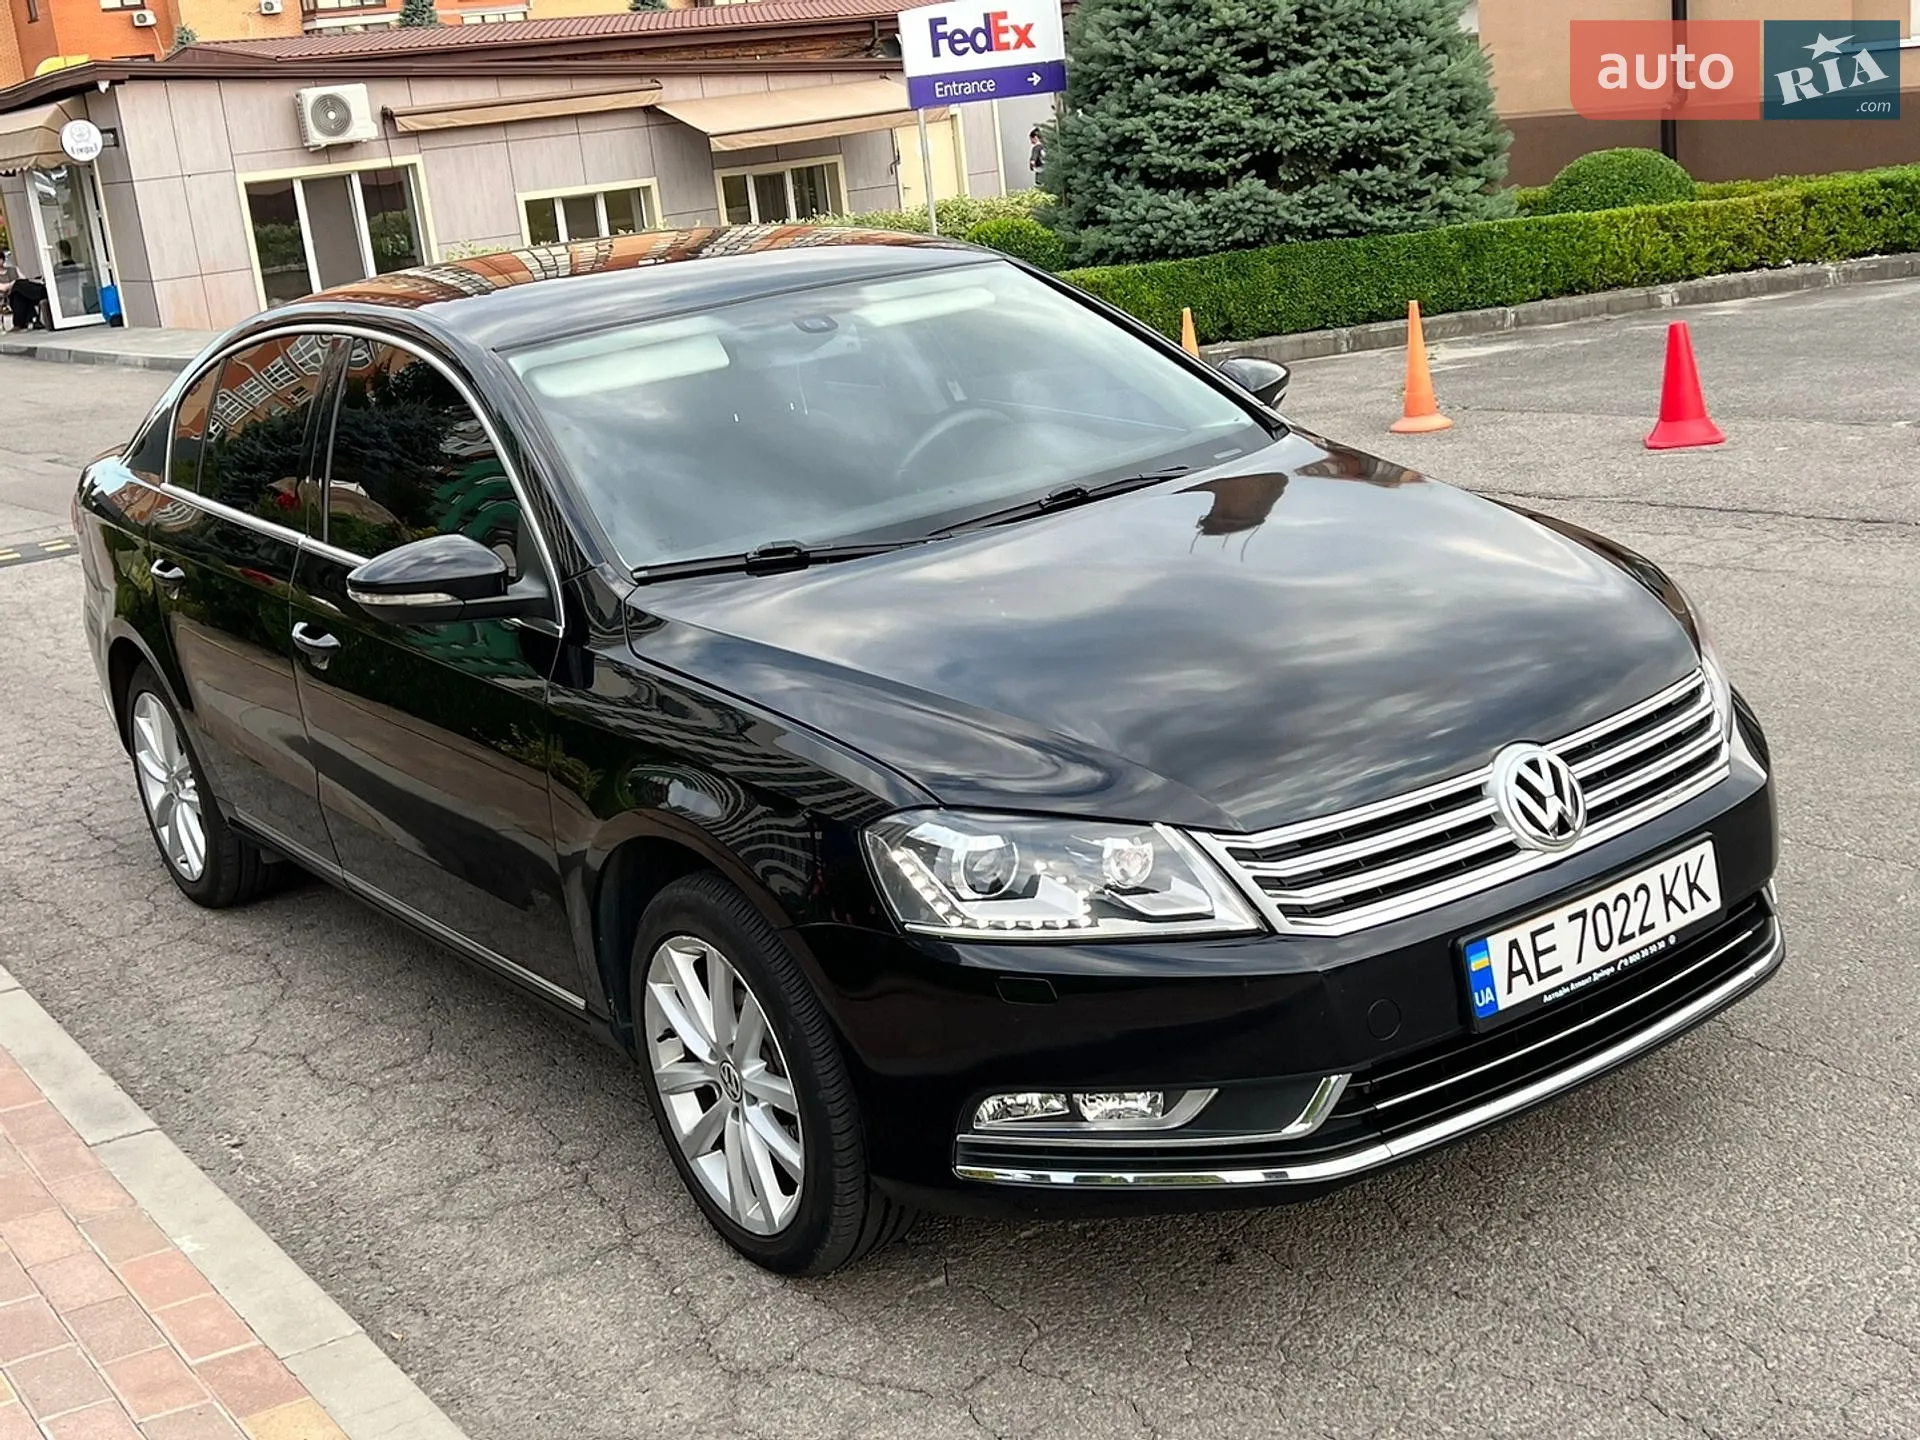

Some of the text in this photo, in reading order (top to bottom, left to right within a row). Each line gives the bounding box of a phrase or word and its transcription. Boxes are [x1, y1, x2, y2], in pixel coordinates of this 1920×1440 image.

[928, 11, 1036, 57] FedEx
[934, 78, 996, 98] Entrance
[1506, 854, 1712, 995] AE 7022 KK
[1475, 989, 1495, 1007] UA
